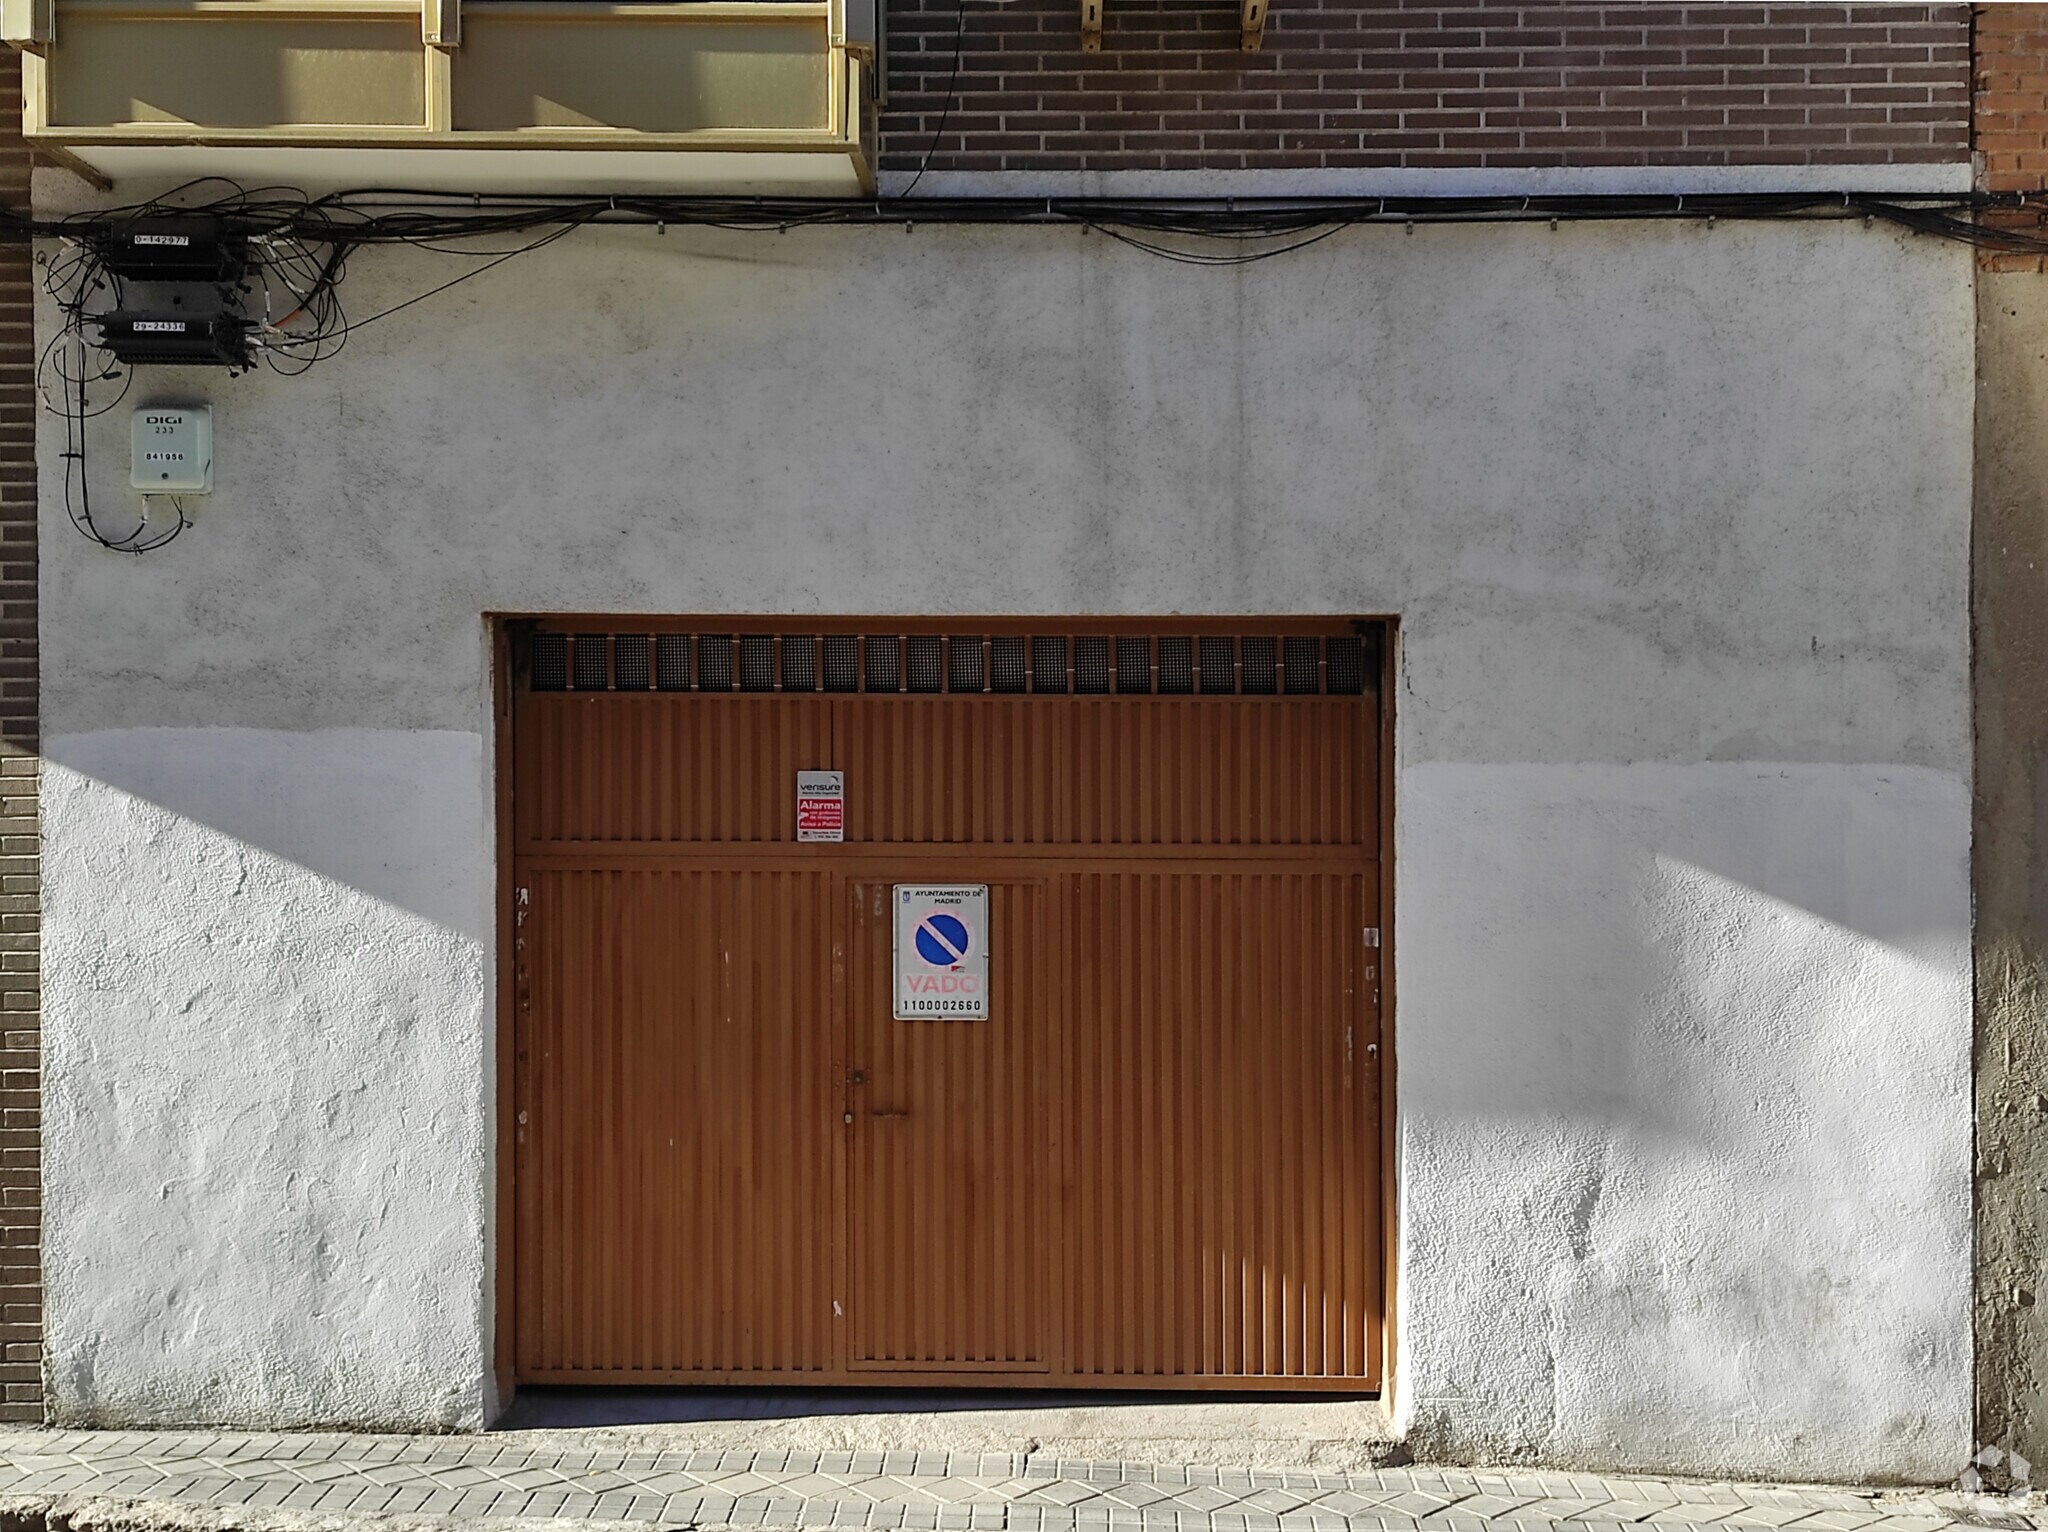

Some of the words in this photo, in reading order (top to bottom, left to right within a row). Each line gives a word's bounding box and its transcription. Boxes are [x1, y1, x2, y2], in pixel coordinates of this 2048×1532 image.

[146, 416, 182, 424] DIGI
[155, 426, 174, 434] 233
[800, 800, 841, 810] Alarma
[906, 975, 979, 993] VADO
[904, 1000, 981, 1010] 1100002660
